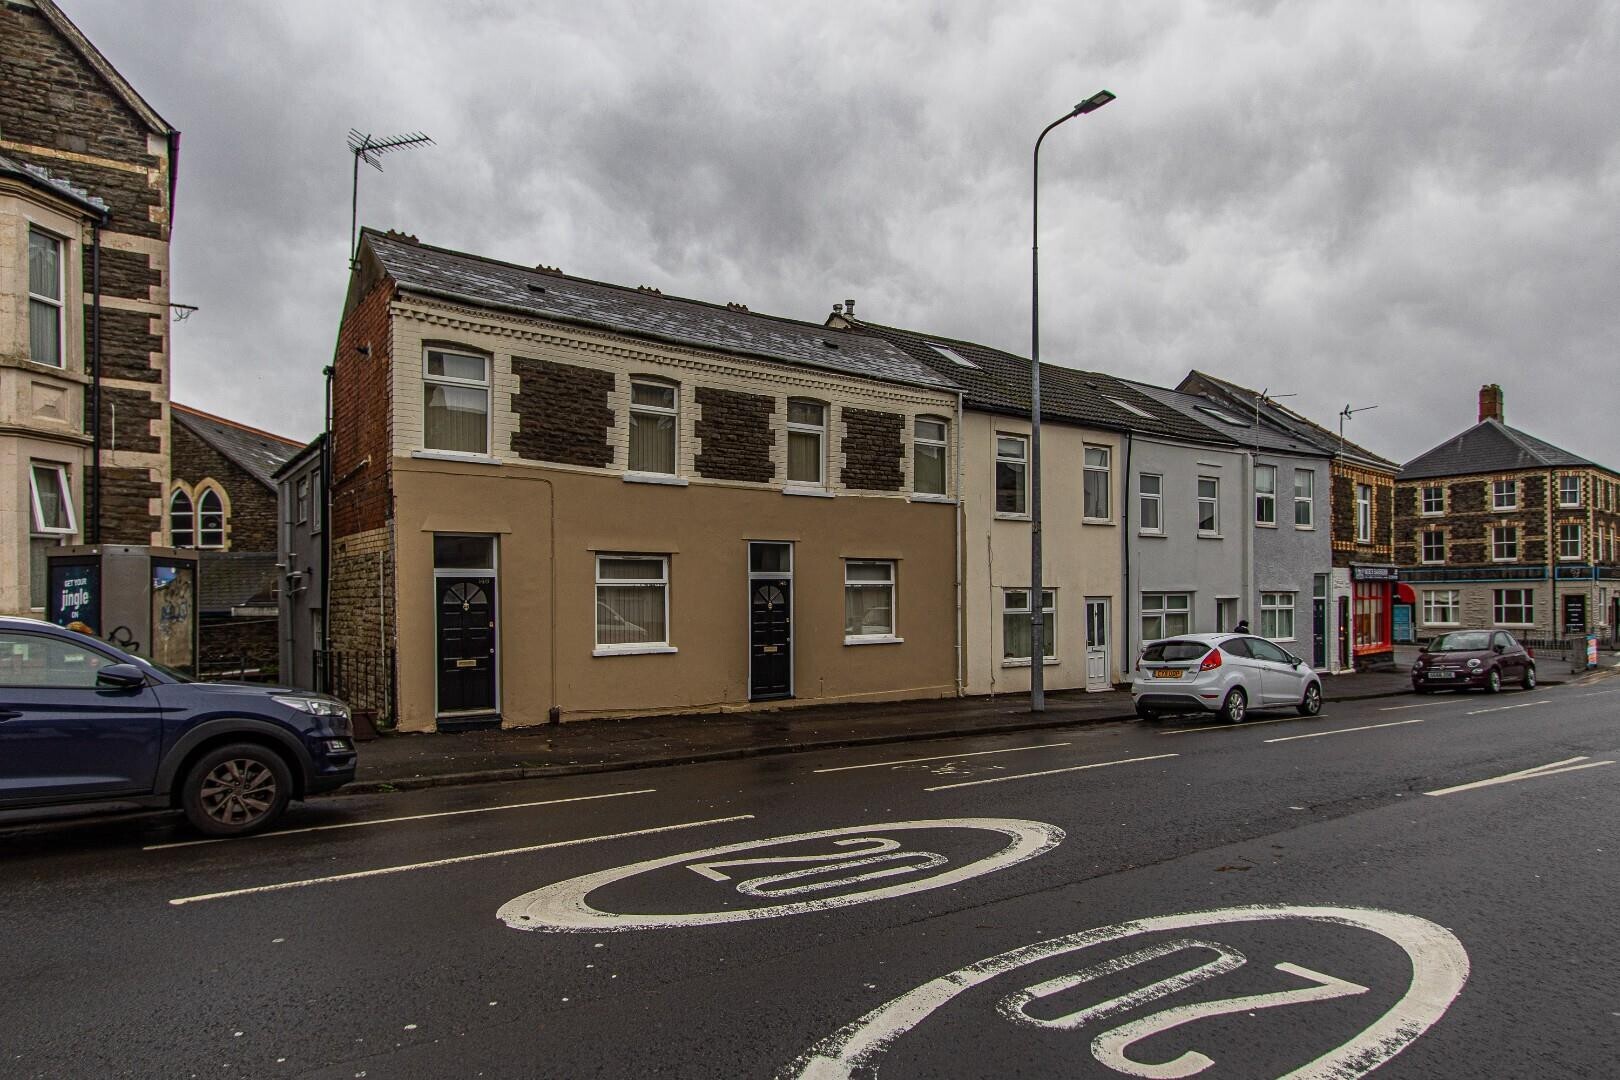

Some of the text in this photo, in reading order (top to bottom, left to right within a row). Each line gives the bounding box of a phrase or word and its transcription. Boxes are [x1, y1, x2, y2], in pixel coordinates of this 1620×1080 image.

[64, 578, 87, 587] GET YOUR
[61, 588, 88, 611] jingle
[71, 611, 79, 619] ON
[685, 837, 949, 898] 20
[995, 937, 1370, 1079] 20
